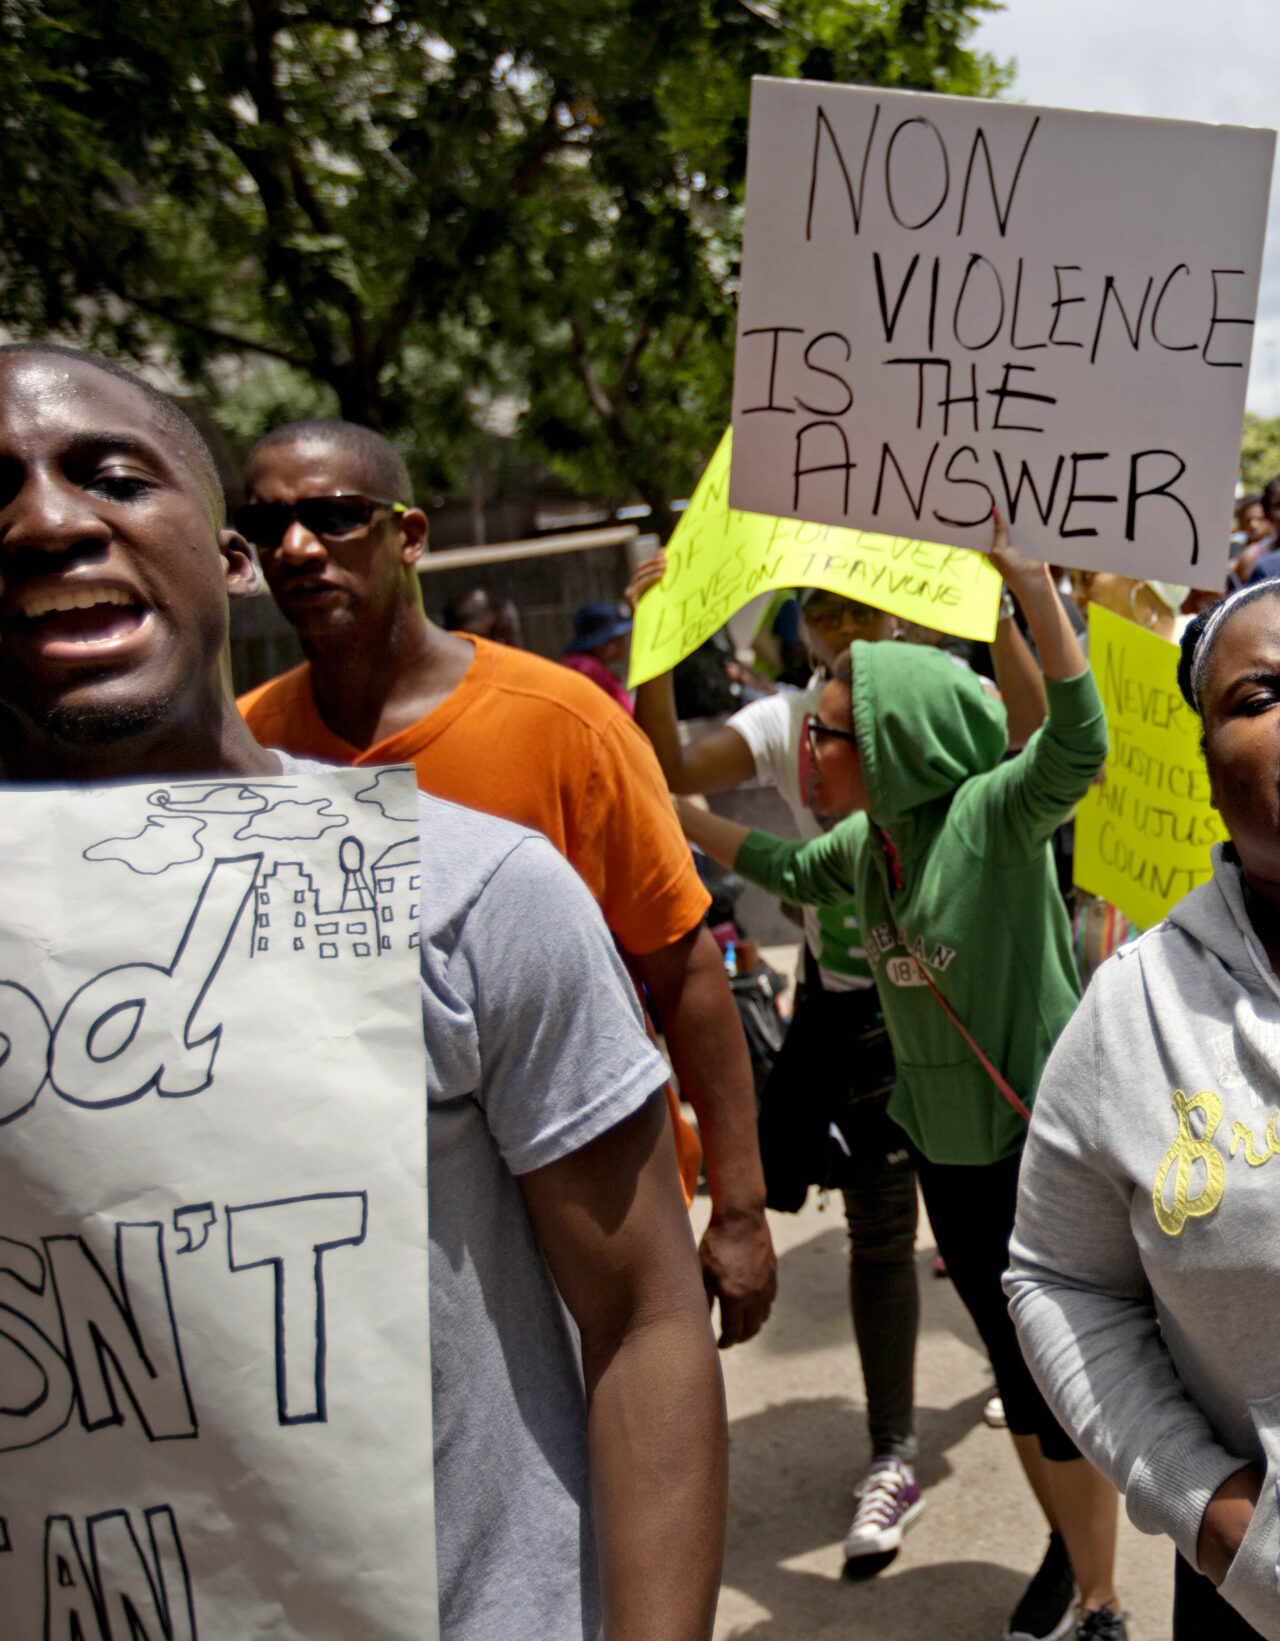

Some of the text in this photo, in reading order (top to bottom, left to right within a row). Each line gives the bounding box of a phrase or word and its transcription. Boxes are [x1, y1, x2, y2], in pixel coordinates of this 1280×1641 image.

[807, 104, 1040, 242] NON
[873, 252, 1254, 367] VIOLENCE
[741, 327, 1057, 436] IS THE
[793, 420, 1199, 565] ANSWER
[746, 555, 783, 593] ON
[1105, 641, 1189, 735] NEVER
[1106, 726, 1212, 802] JUSTICE
